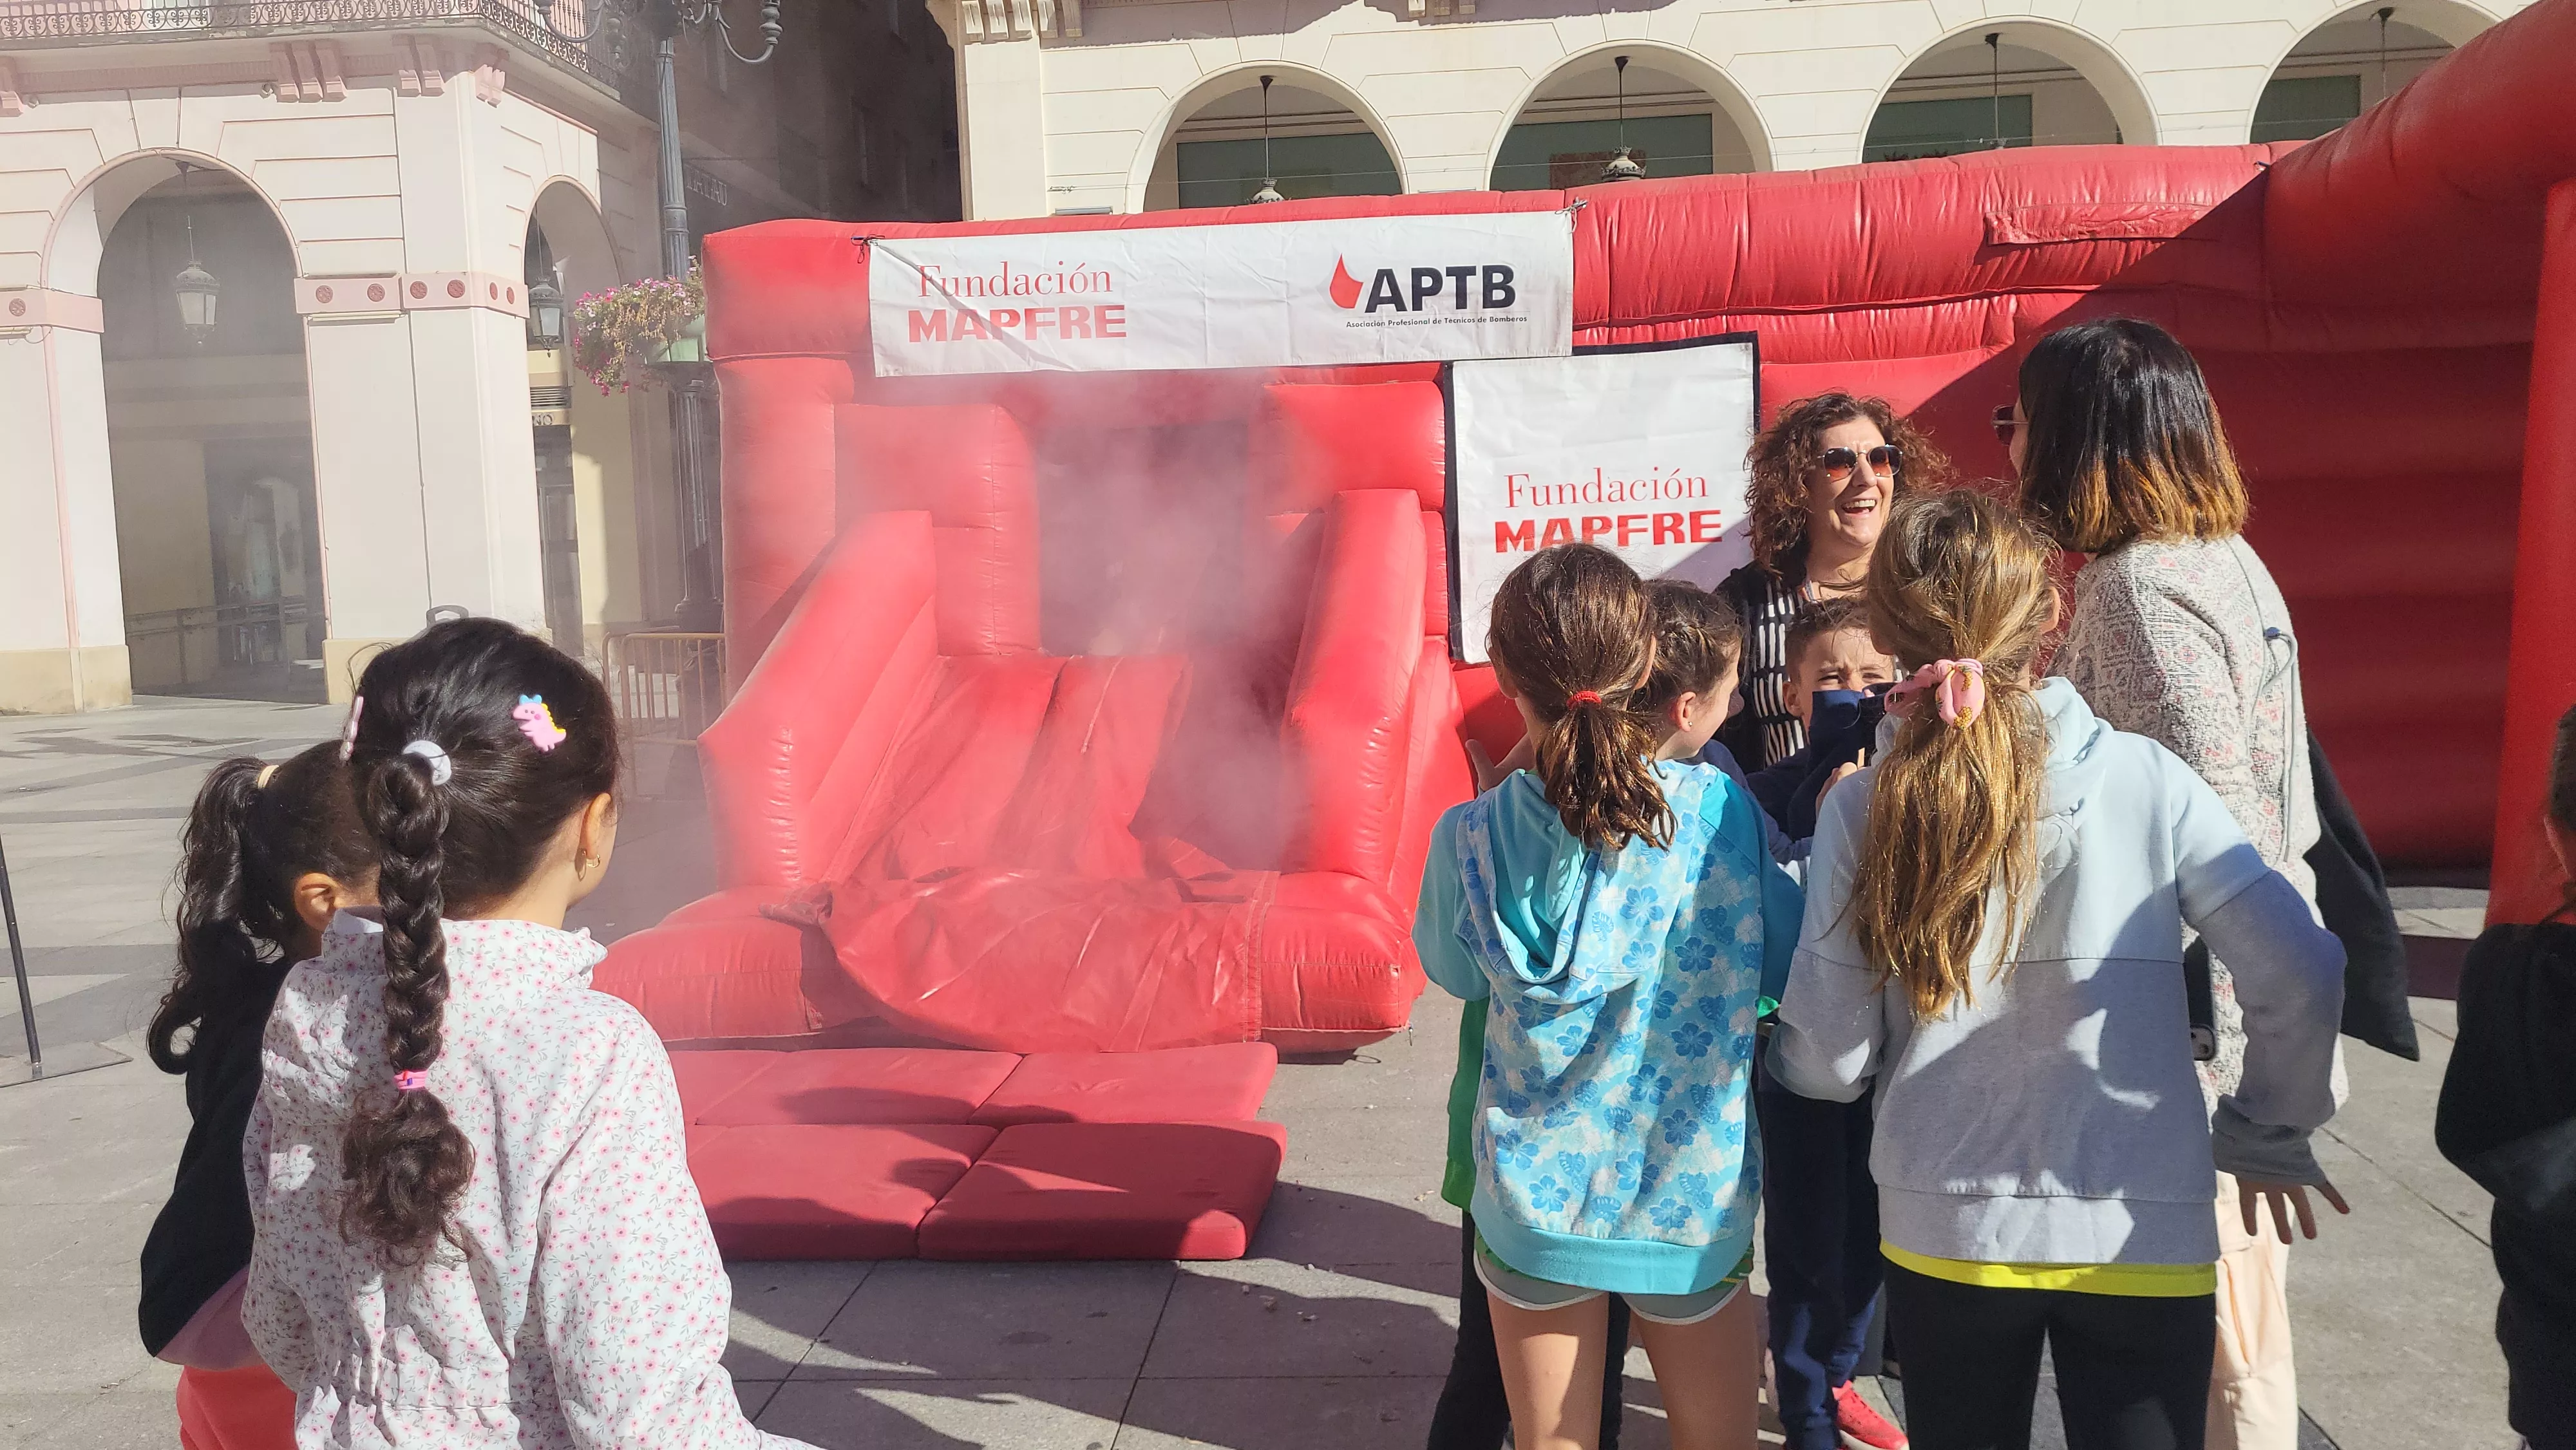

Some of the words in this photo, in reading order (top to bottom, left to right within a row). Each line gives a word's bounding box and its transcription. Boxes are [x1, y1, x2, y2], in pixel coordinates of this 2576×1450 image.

[917, 261, 1113, 297] Fundación
[1365, 265, 1516, 313] APTB
[908, 305, 1127, 343] MAPFRE
[1504, 466, 1709, 508] Fundación
[1495, 509, 1723, 553] MAPFRE
